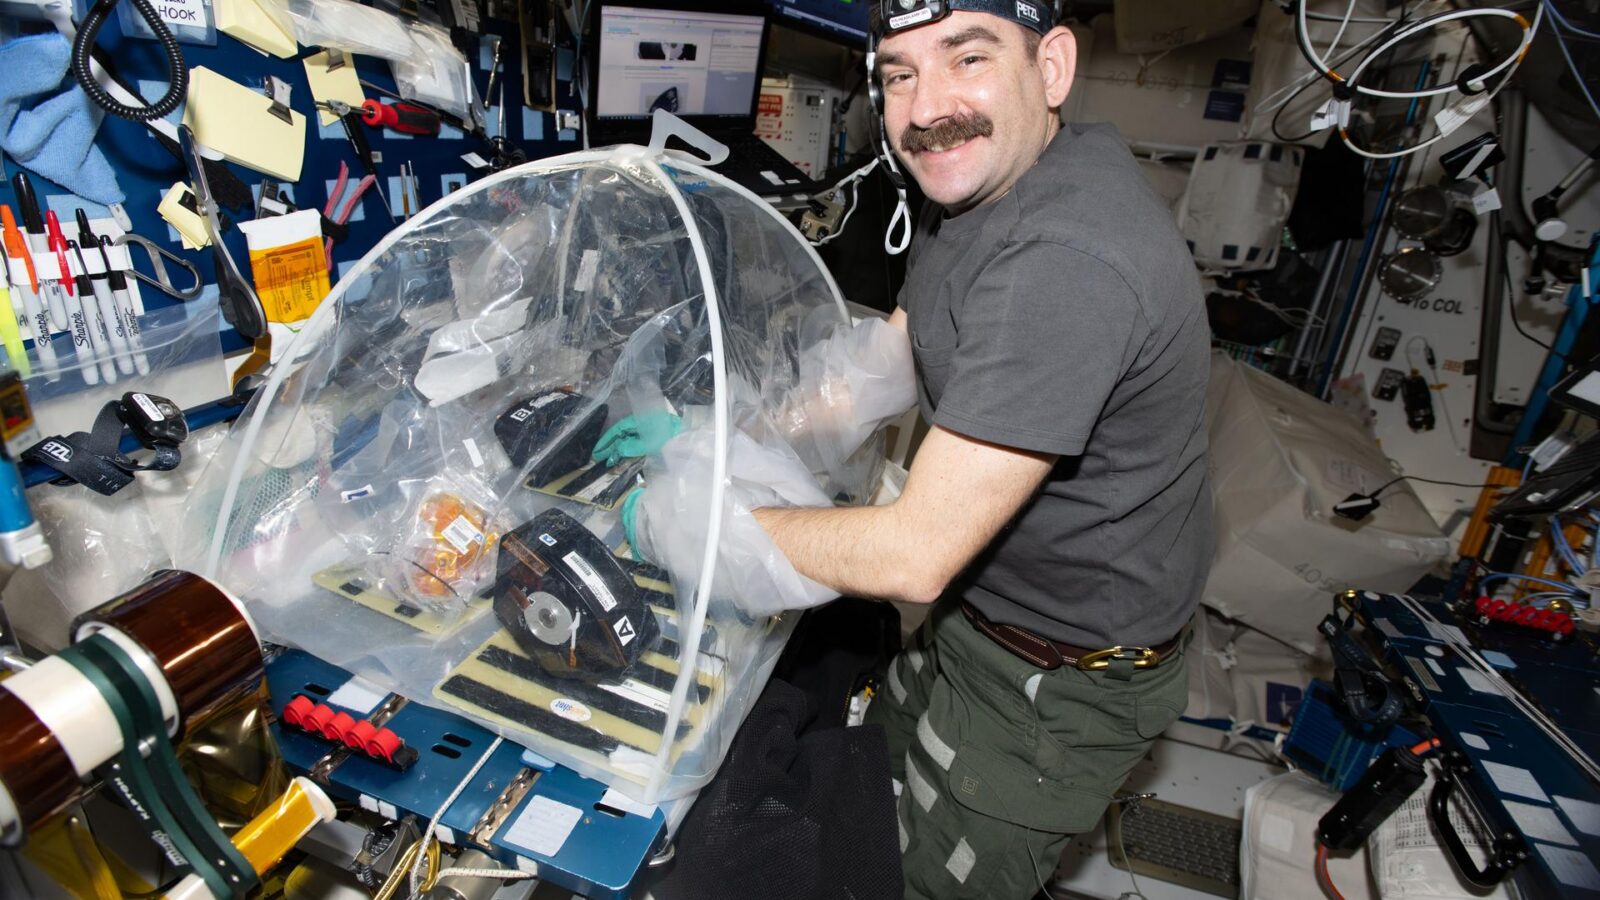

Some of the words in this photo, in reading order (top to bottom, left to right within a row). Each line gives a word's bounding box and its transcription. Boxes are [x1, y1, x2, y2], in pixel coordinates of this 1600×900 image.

[158, 5, 196, 21] HOOK
[1016, 1, 1040, 21] PETZL
[1432, 298, 1464, 315] COL
[35, 312, 50, 348] Sharpie
[71, 310, 90, 349] Sharpie
[42, 440, 70, 462] ETZL
[618, 618, 634, 638] A
[114, 777, 150, 820] KAPTON
